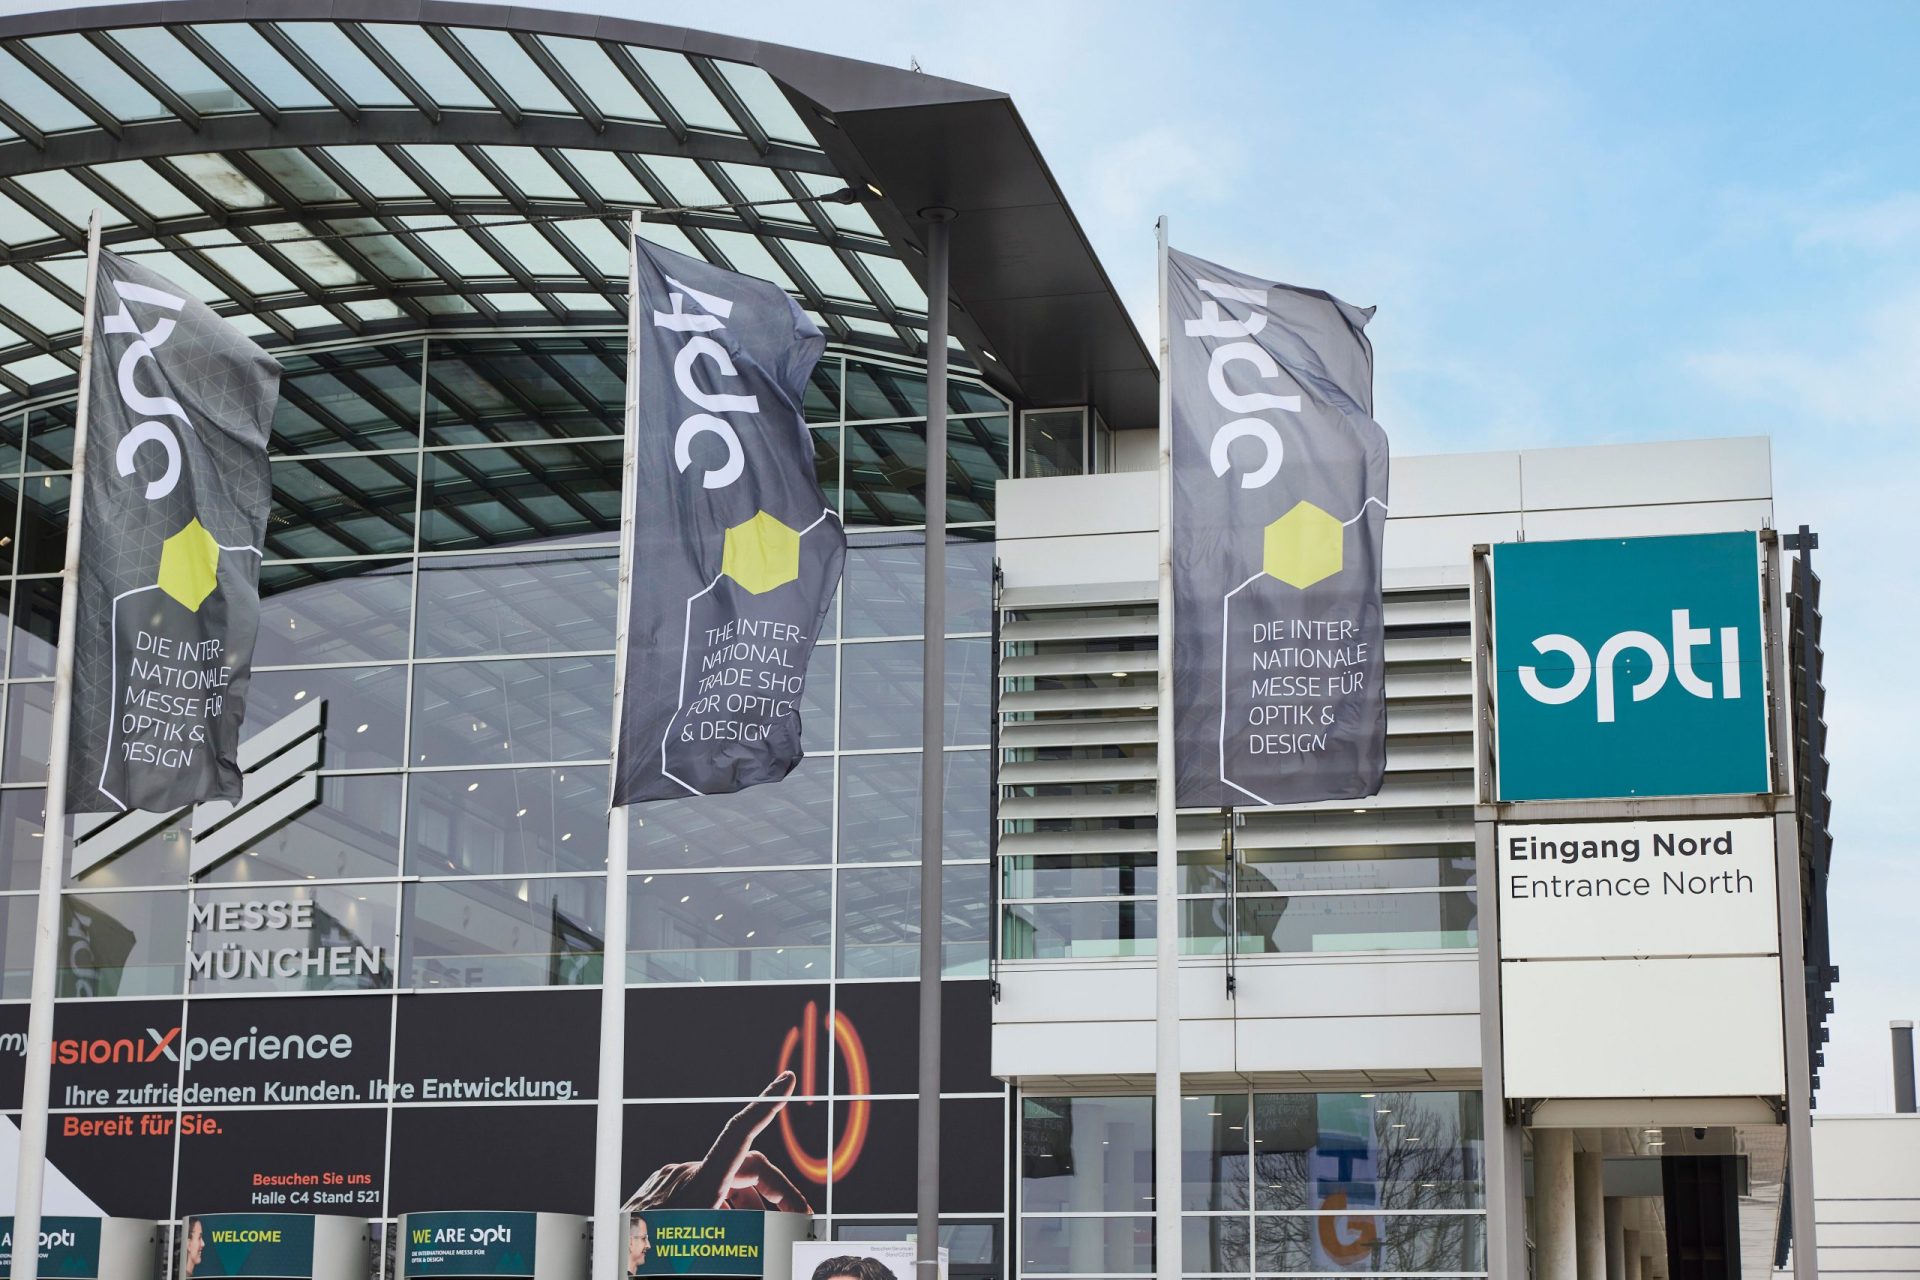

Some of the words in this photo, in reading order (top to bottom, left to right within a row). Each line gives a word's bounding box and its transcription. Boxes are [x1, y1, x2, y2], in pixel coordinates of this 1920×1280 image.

[1184, 279, 1301, 489] opti
[705, 620, 735, 647] THE
[736, 618, 807, 643] INTER-
[1253, 620, 1284, 643] DIE
[1291, 620, 1360, 640] INTER-
[136, 631, 173, 658] DIE
[177, 639, 224, 661] INTER-
[702, 643, 794, 672] NATIONAL
[1253, 643, 1367, 671] NATIONALE
[130, 657, 232, 689] NATIONALE
[1518, 608, 1741, 723] opti
[699, 668, 753, 695] TRADE
[758, 671, 803, 693] SHO
[1251, 676, 1321, 698] MESSE
[1328, 671, 1364, 697] FÜR
[125, 686, 199, 717] MESSE
[204, 693, 223, 718] FÜR
[686, 695, 720, 717] FOR
[1249, 705, 1314, 725] OPTIK
[1320, 705, 1335, 725] &
[122, 714, 186, 742] OPTIK
[188, 725, 206, 743] &
[681, 723, 694, 741] &
[700, 720, 772, 741] DESIGN
[1250, 733, 1327, 754] DESIGN
[1510, 836, 1640, 864] Eingang
[1653, 831, 1733, 857] Nord
[1511, 874, 1650, 899] Entrance
[1663, 869, 1753, 895] North
[188, 900, 314, 931] MESSE
[187, 943, 381, 979] MÜNCHEN
[65, 1085, 109, 1106] Ihre
[116, 1082, 256, 1105] zufriedenen
[264, 1080, 361, 1101] Kunden.
[369, 1079, 414, 1100] Ihre
[422, 1076, 578, 1101] Entwicklung.
[63, 1115, 134, 1137] Bereit
[140, 1114, 173, 1136] für
[181, 1114, 223, 1135] Sie.
[253, 1173, 319, 1186] Besuchen
[323, 1172, 343, 1184] Sie
[347, 1174, 371, 1185] uns
[251, 1192, 286, 1205] Halle
[290, 1191, 309, 1204] C4
[313, 1190, 353, 1203] Stand
[357, 1190, 380, 1203] 521
[212, 1230, 281, 1243] WELCOME
[412, 1229, 432, 1244] WE
[434, 1228, 466, 1243] ARE
[470, 1225, 511, 1246] opti
[656, 1227, 725, 1239] HERZLICH
[655, 1245, 758, 1258] WILLKOMMEN
